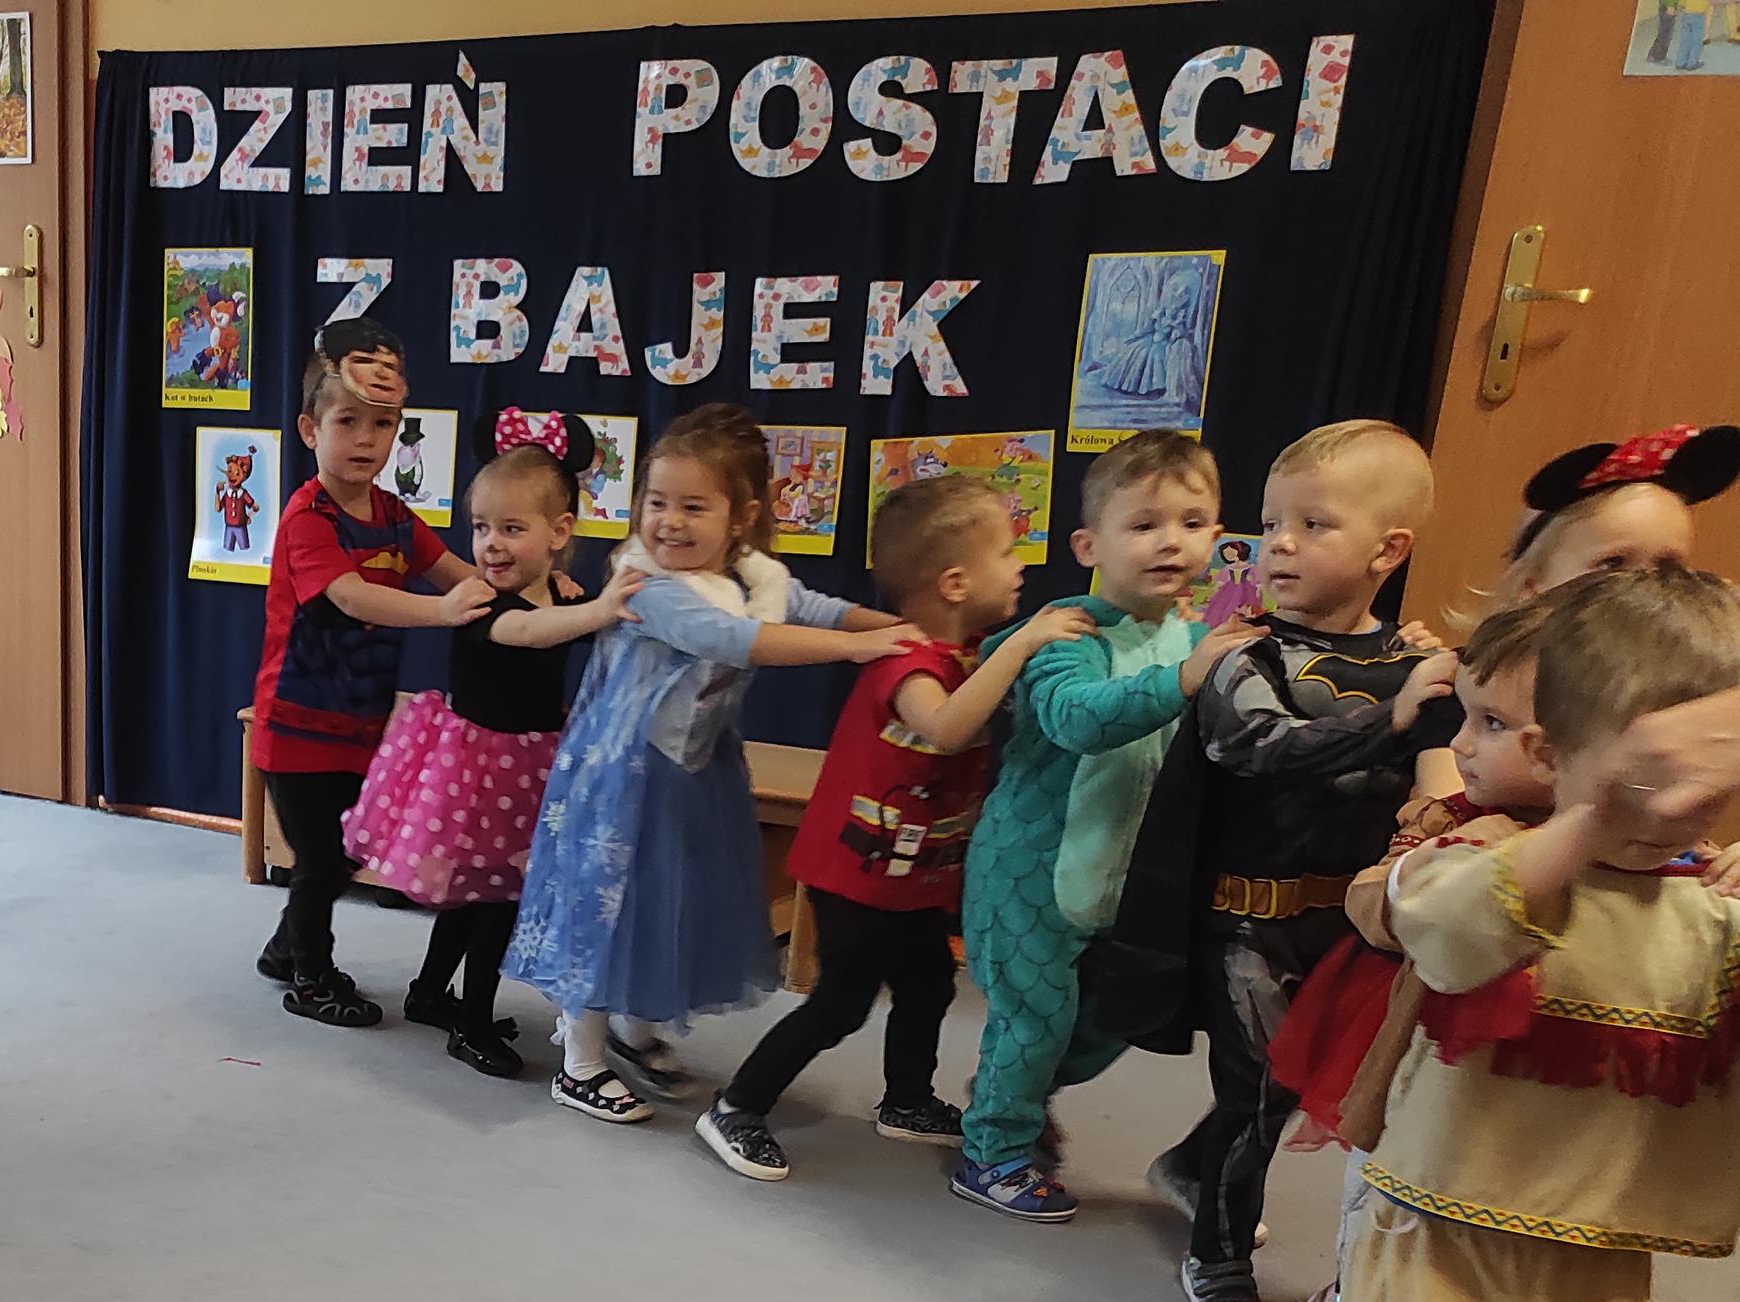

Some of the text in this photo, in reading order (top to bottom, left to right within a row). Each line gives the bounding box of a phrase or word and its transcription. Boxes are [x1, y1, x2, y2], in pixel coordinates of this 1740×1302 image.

[632, 33, 1356, 185] POSTACI
[315, 257, 982, 398] Z BAJEK
[1071, 434, 1114, 445] Królowa
